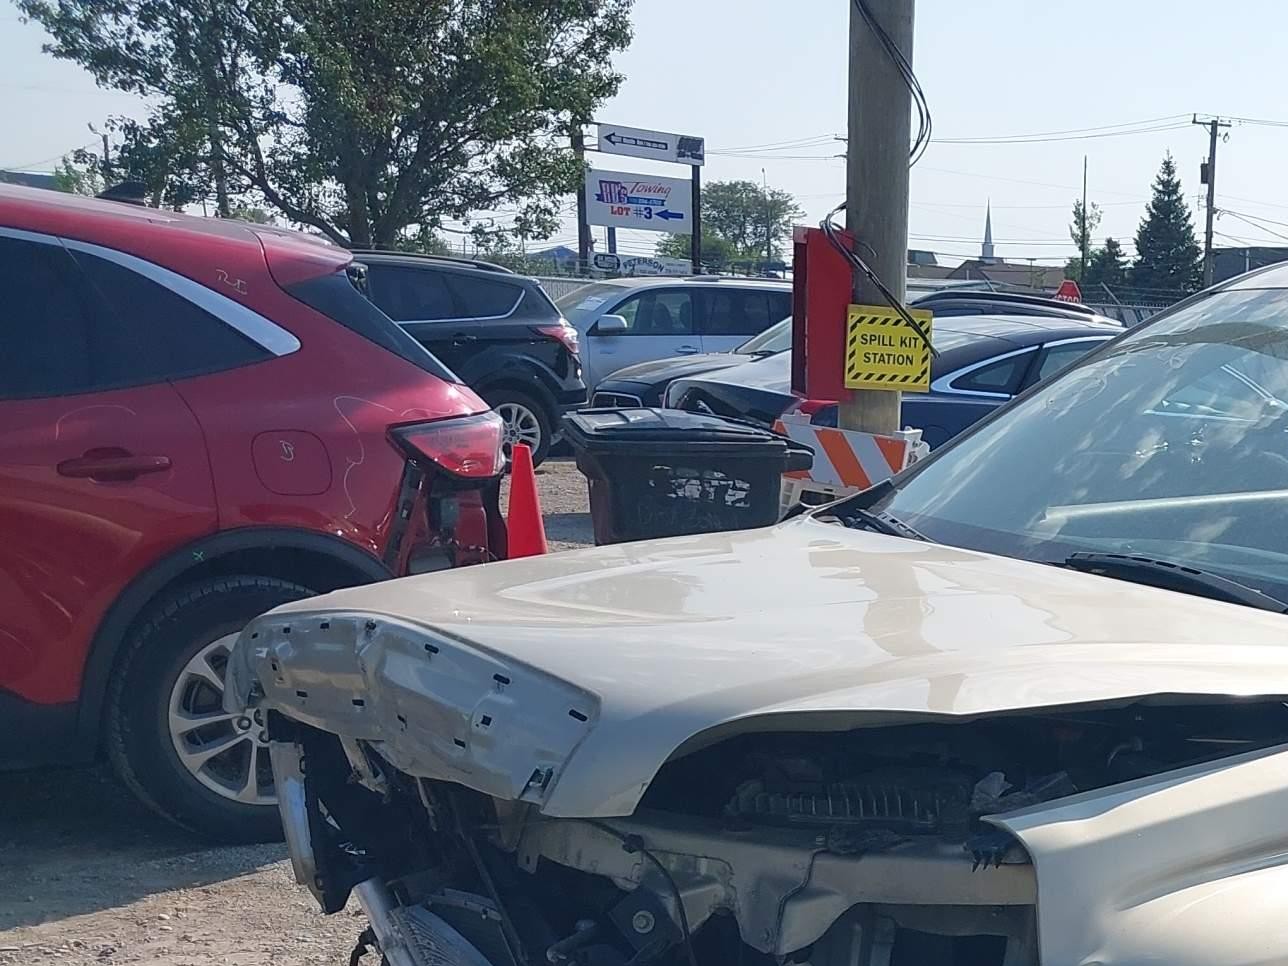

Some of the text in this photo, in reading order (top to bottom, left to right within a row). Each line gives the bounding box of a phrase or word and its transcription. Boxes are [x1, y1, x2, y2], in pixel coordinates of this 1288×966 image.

[627, 182, 672, 198] Towing
[610, 205, 653, 219] LOT #3
[860, 333, 920, 348] SPILL KIT
[863, 351, 914, 366] STATION
